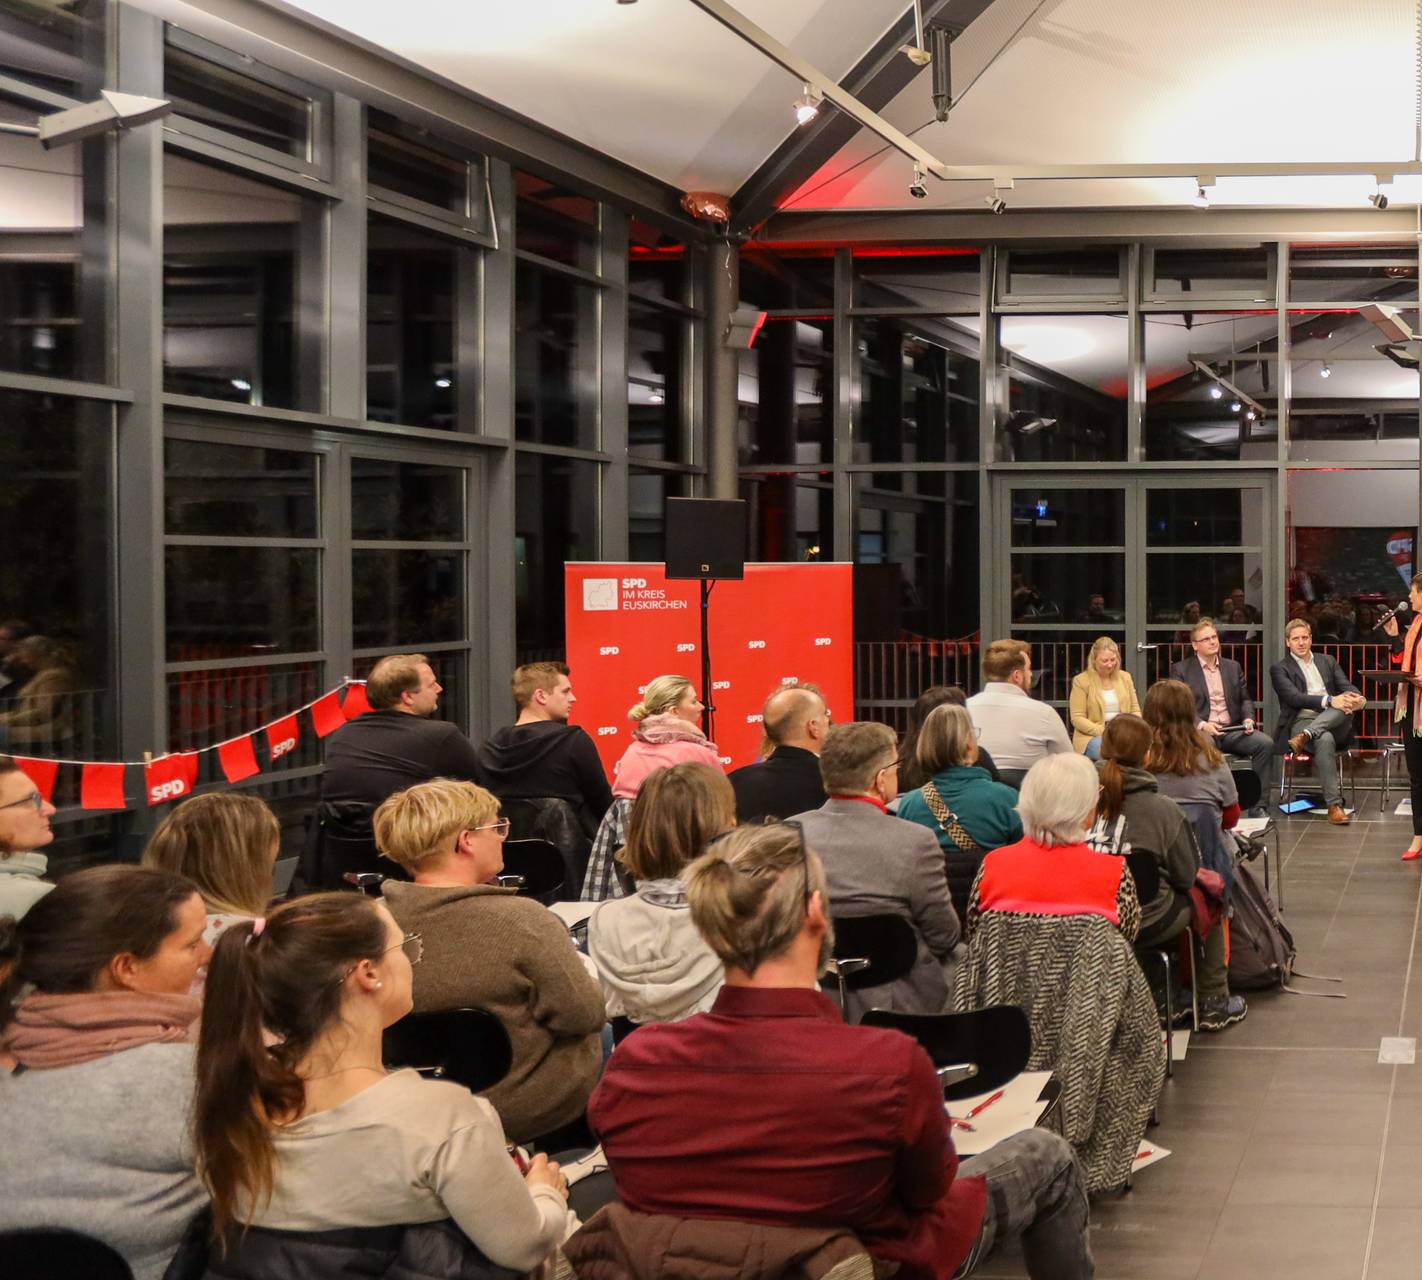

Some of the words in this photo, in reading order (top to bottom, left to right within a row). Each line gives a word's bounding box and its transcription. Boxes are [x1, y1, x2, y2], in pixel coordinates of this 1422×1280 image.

[622, 578, 647, 589] SPD
[622, 590, 635, 599] IM
[637, 589, 666, 599] KREIS
[622, 600, 688, 610] EUSKIRCHEN
[748, 640, 766, 649] SPD
[815, 637, 832, 646] SPD
[599, 646, 620, 656] SPD
[676, 643, 696, 653] SPD
[712, 681, 731, 690] SPD
[782, 677, 799, 686] SPD
[746, 714, 764, 723] SPD
[598, 726, 618, 736] SPD
[272, 737, 296, 759] SPD
[151, 779, 185, 802] SPD
